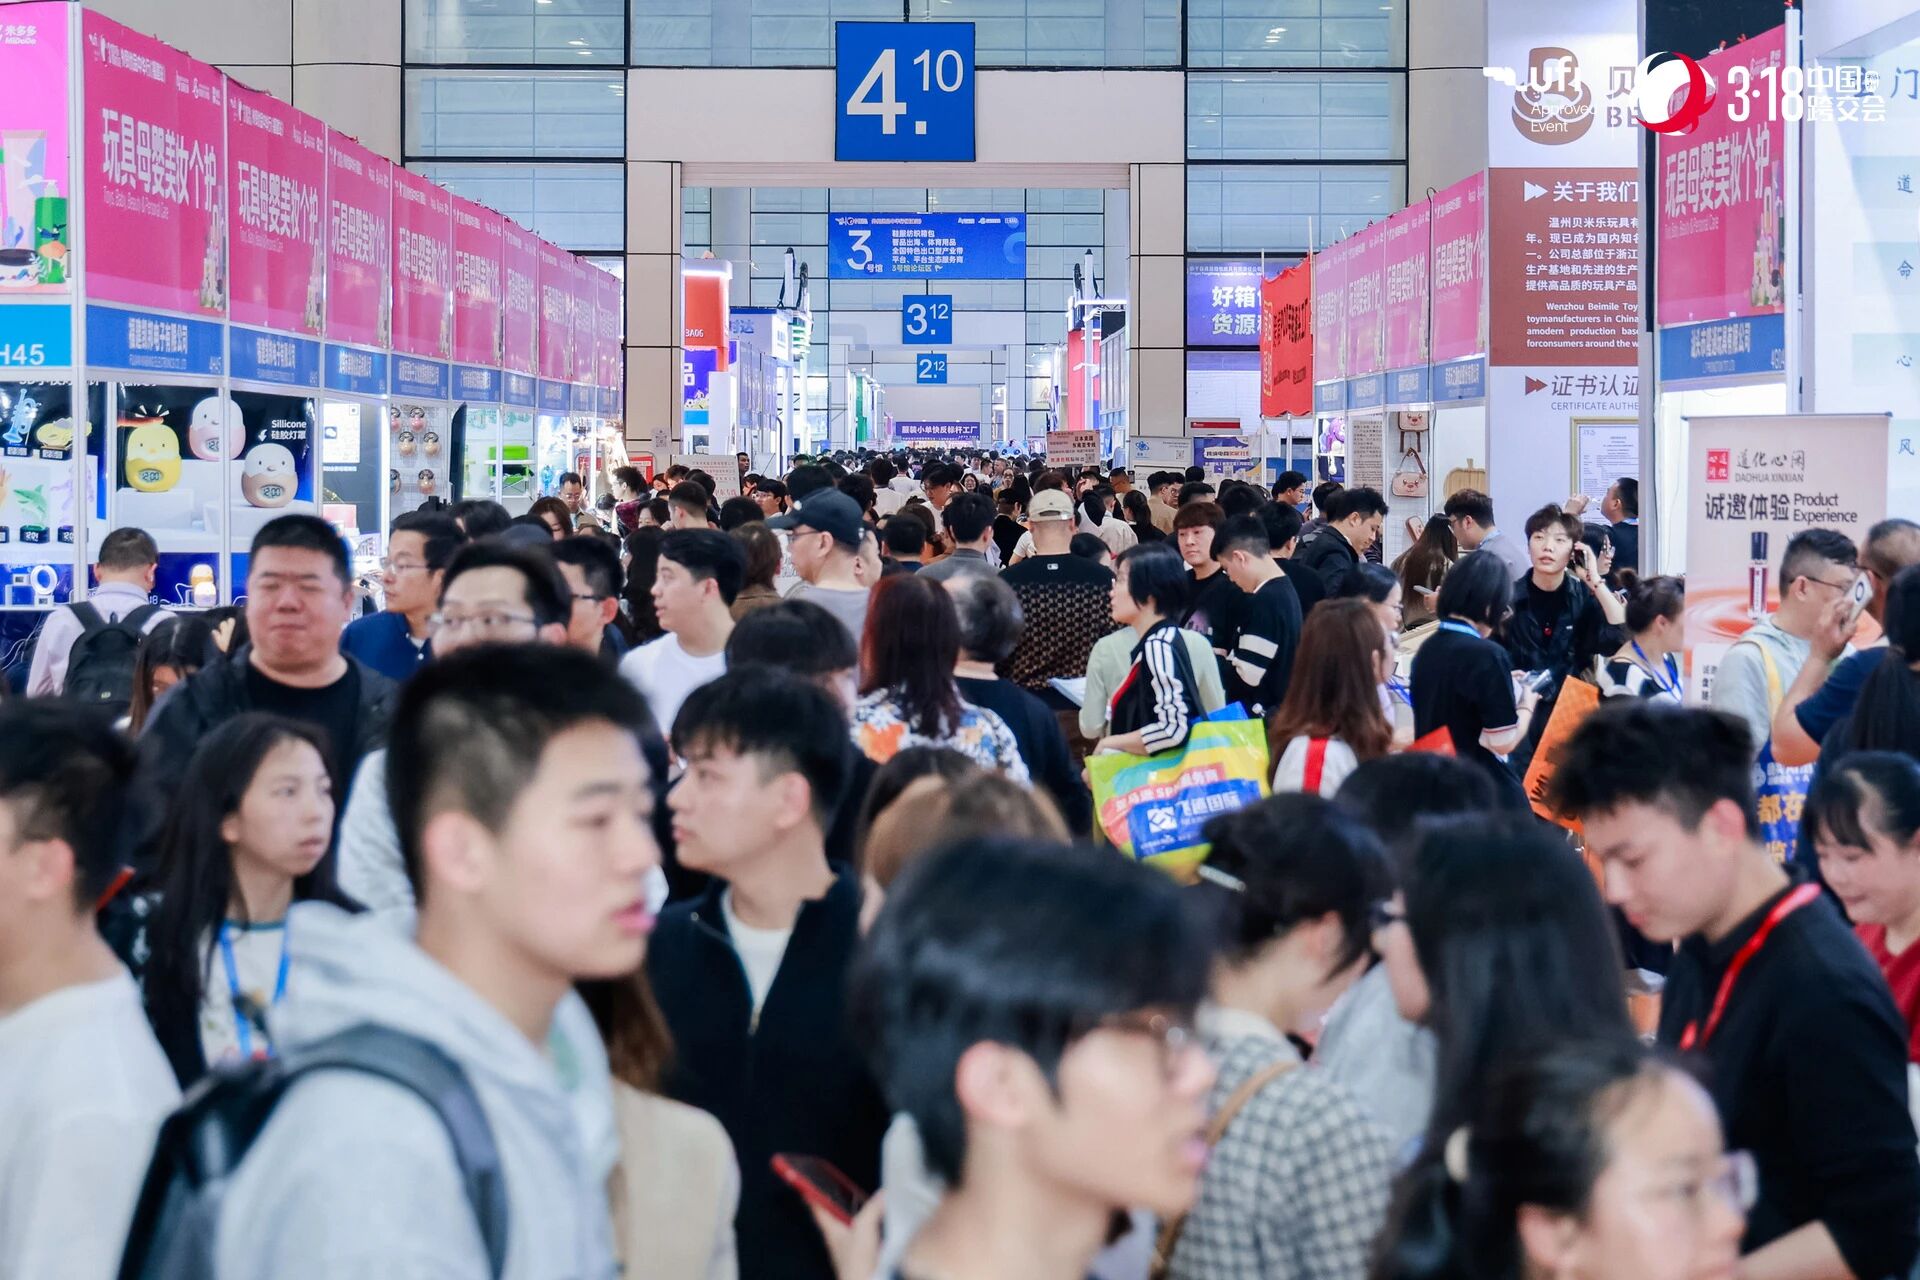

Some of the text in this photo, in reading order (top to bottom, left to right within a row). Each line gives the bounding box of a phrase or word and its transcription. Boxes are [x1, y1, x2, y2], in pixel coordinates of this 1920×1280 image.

[102, 108, 217, 213] 玩具母婴美妆个护
[1665, 122, 1770, 218] 玩具母婴美妆个护
[1553, 181, 1638, 202] 关于我们
[1897, 174, 1913, 194] 道
[1549, 217, 1638, 228] 温州贝米乐玩具有
[847, 230, 873, 271] 3
[1526, 264, 1638, 275] 生产基地和先进的生产
[1897, 260, 1914, 280] 命
[1526, 280, 1637, 291] 提供高品质的玩具产品
[1212, 286, 1261, 308] 好箱
[1546, 302, 1584, 311] Wenzhou
[1588, 302, 1619, 311] Beimile
[1212, 314, 1261, 335] 货源
[1604, 315, 1612, 323] in
[1526, 327, 1564, 335] amodern
[1570, 327, 1616, 336] production
[1526, 339, 1584, 348] forconsumers
[1585, 339, 1614, 348] around
[1616, 339, 1630, 348] the
[1896, 355, 1912, 367] 心
[1552, 374, 1638, 396] 证书认证
[1551, 402, 1607, 411] CERTIFICATE
[1898, 438, 1915, 456] 风
[1705, 493, 1790, 521] 诚邀体验
[1794, 493, 1839, 508] Product
[1793, 508, 1858, 525] Experience
